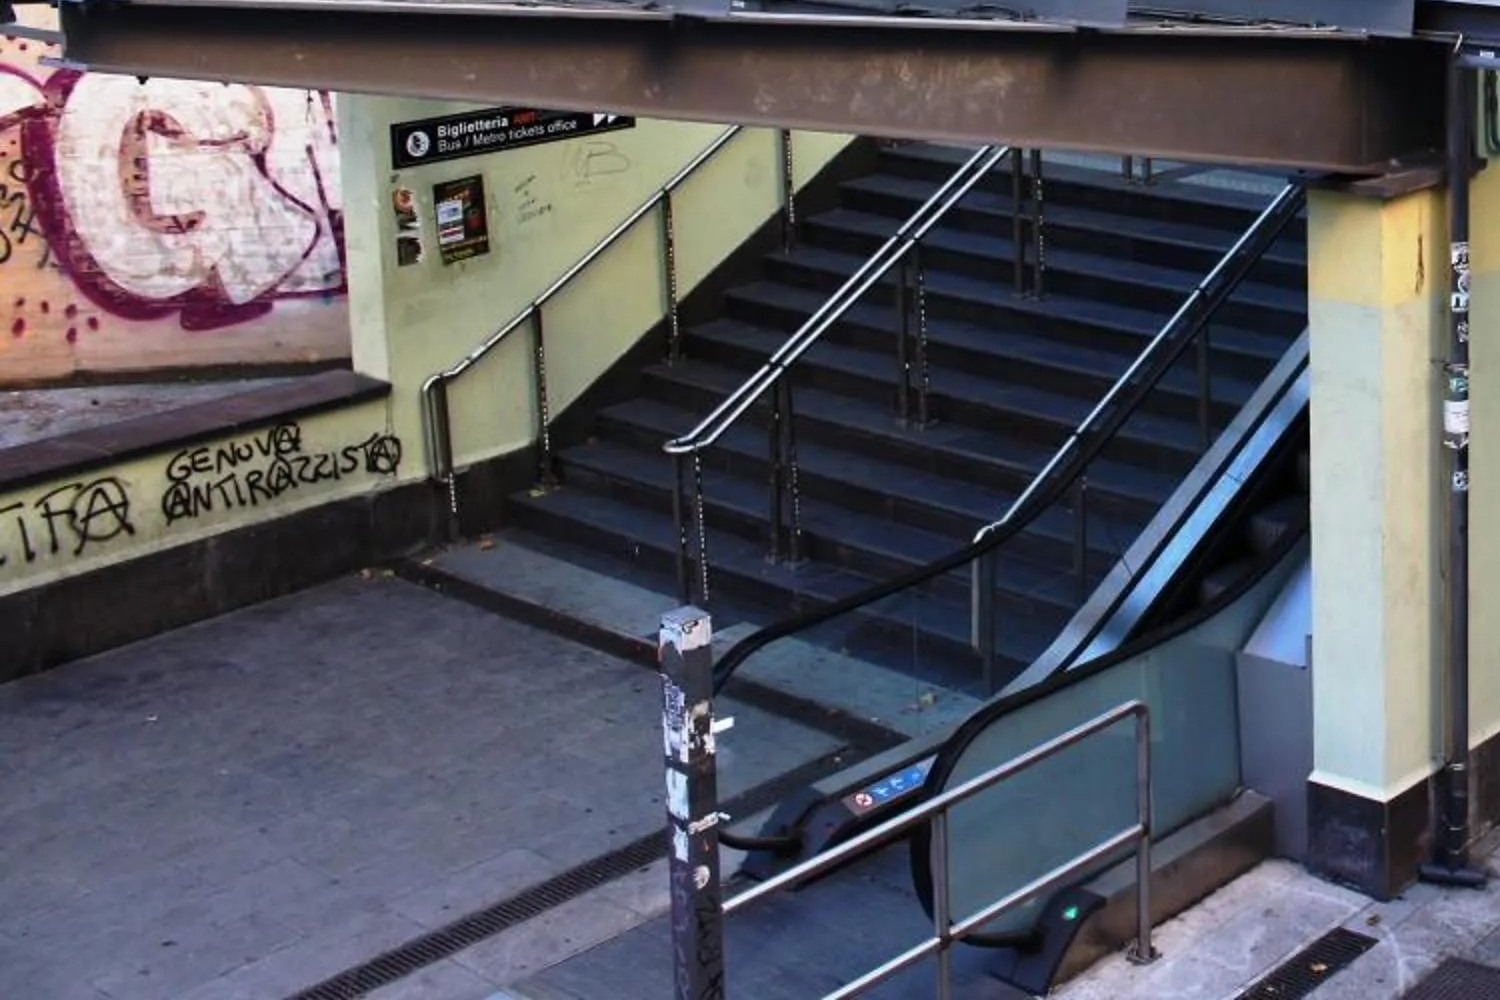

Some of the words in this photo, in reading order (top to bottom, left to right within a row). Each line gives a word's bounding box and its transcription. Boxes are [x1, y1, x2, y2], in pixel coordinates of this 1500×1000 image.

[437, 115, 509, 138] Biglietteria
[438, 138, 460, 152] Bus
[473, 131, 506, 147] Metro
[508, 124, 545, 141] tickets
[547, 118, 577, 133] office
[166, 421, 301, 482] GENOVA
[161, 432, 402, 526] ANTIRAZZISTA
